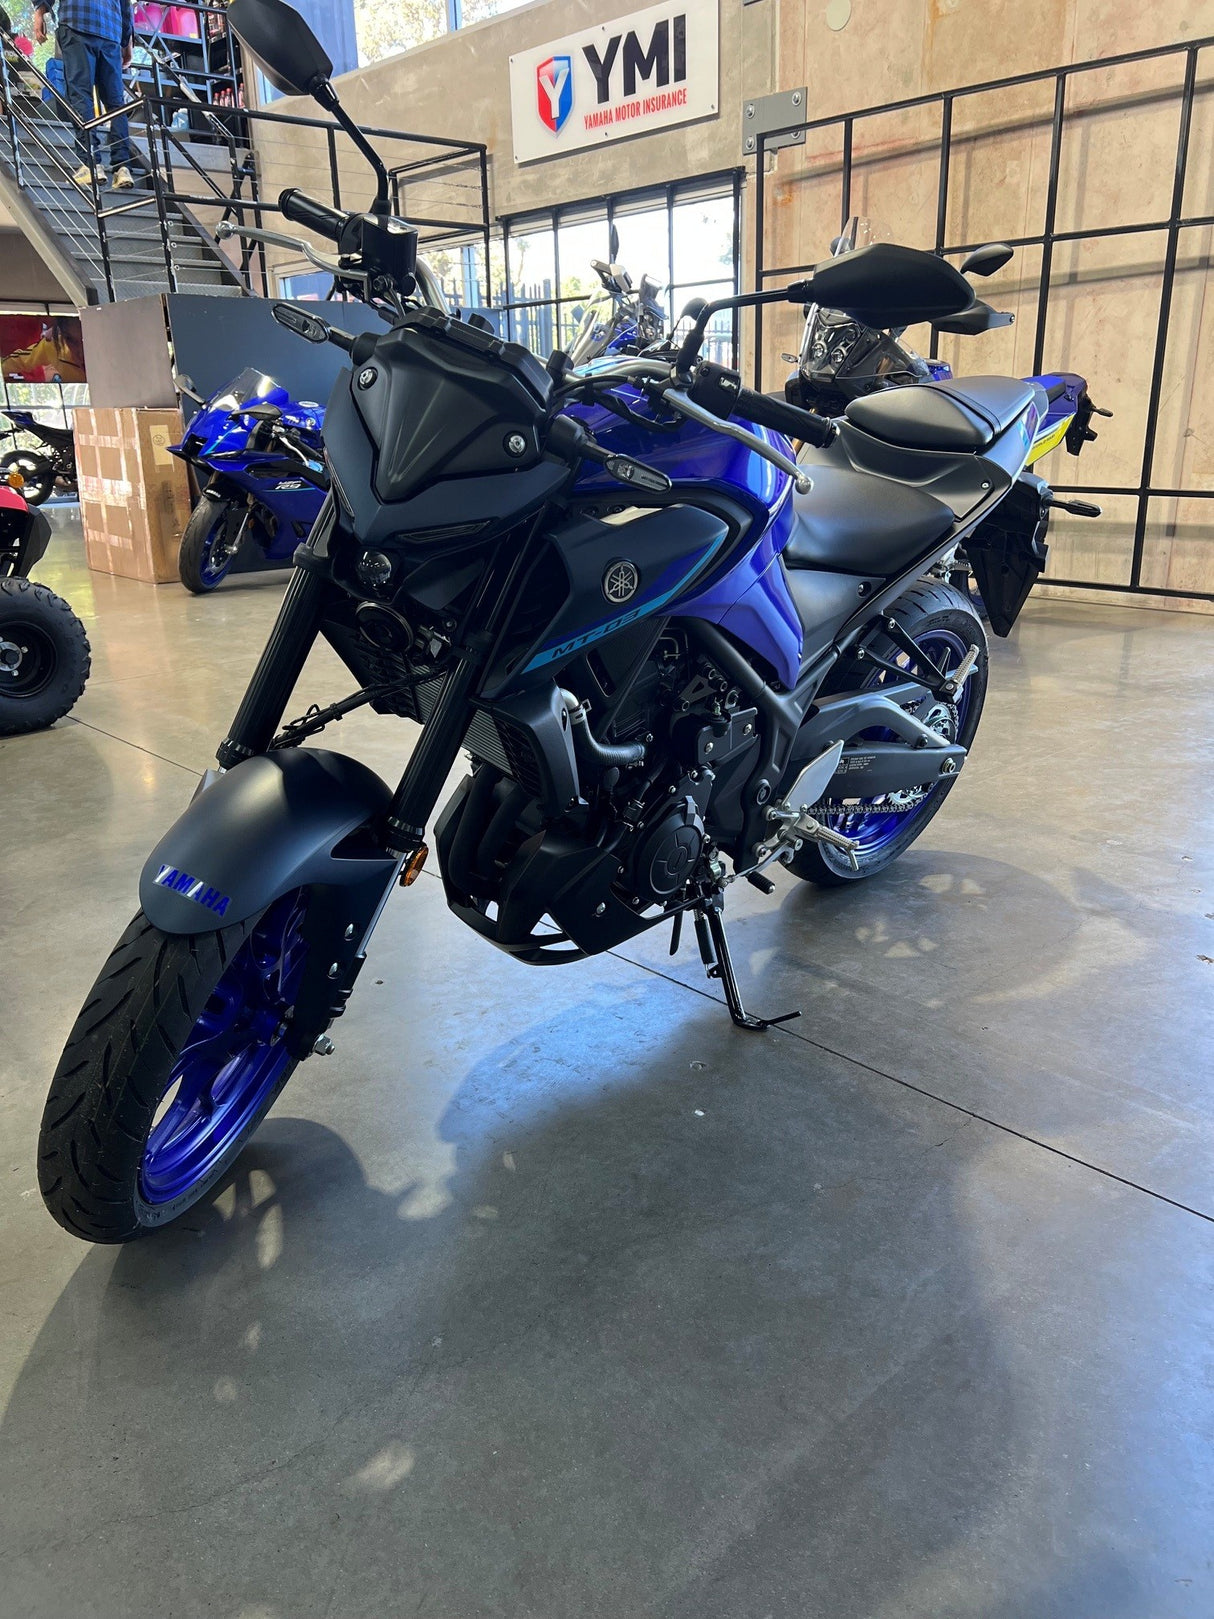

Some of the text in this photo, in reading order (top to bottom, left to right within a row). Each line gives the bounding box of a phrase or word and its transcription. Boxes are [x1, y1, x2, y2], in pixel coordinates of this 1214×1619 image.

[582, 13, 687, 105] YMI
[584, 88, 687, 130] YAMAHA MOTOR INSURANCE
[551, 608, 642, 659] MT-03
[153, 864, 231, 917] YAMAHA
